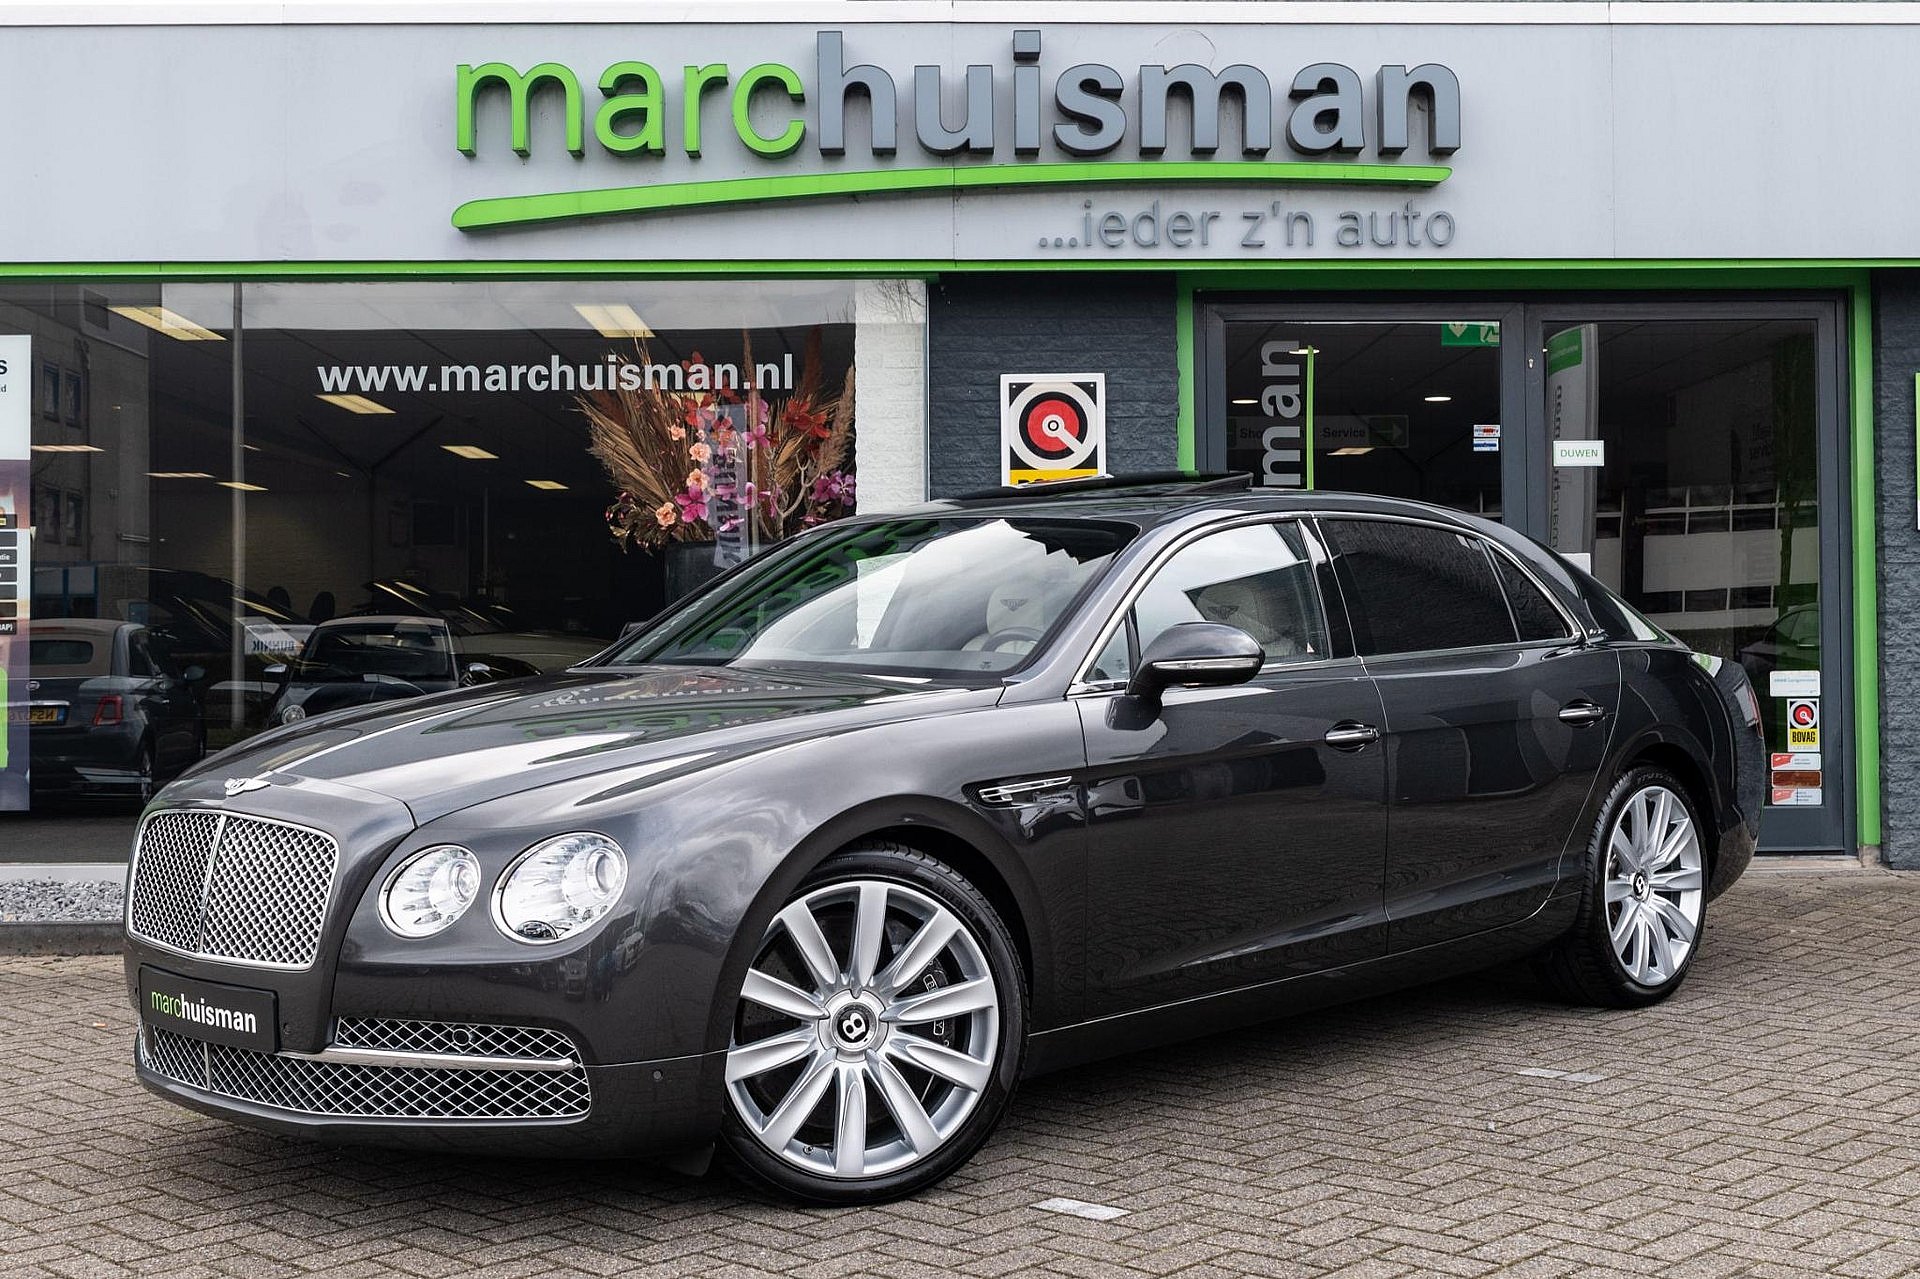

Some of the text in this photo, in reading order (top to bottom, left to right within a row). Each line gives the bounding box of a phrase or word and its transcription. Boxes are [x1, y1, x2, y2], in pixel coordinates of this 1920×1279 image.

[455, 29, 1462, 158] marchuisman
[1241, 200, 1314, 247] z'n
[1336, 203, 1456, 247] auto
[316, 353, 793, 392] www.marchuisman.nl
[1322, 426, 1366, 438] Service
[1560, 449, 1598, 457] DUWEN
[1792, 731, 1816, 743] BOVAG
[151, 990, 257, 1034] marchuisman
